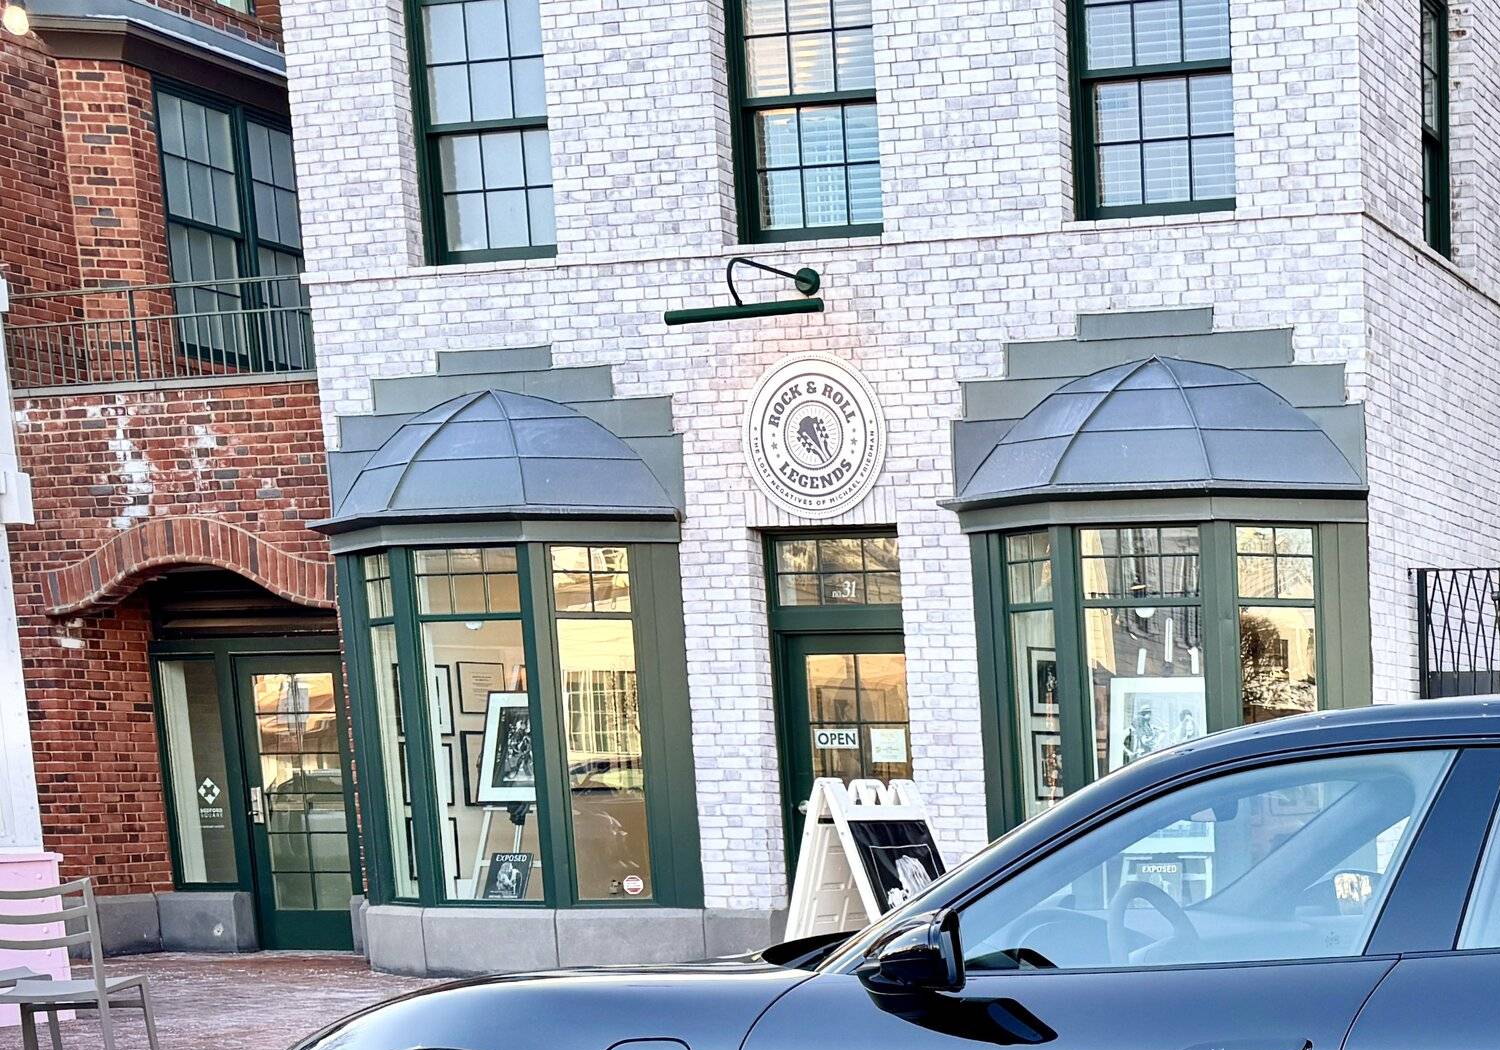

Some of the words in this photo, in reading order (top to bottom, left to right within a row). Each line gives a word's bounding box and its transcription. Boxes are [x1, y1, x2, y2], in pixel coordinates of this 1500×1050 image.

[768, 384, 802, 428] ROCK
[806, 381, 817, 394] &
[821, 384, 856, 423] ROLL
[758, 457, 770, 478] LOST
[771, 480, 812, 506] NEGATIVES
[829, 480, 860, 504] MICHAEL
[860, 430, 875, 477] FRIEDMAN
[779, 458, 852, 489] LEGENDS
[818, 733, 856, 745] OPEN
[496, 854, 527, 862] EXPOSED
[1142, 864, 1177, 873] EXPOSED
